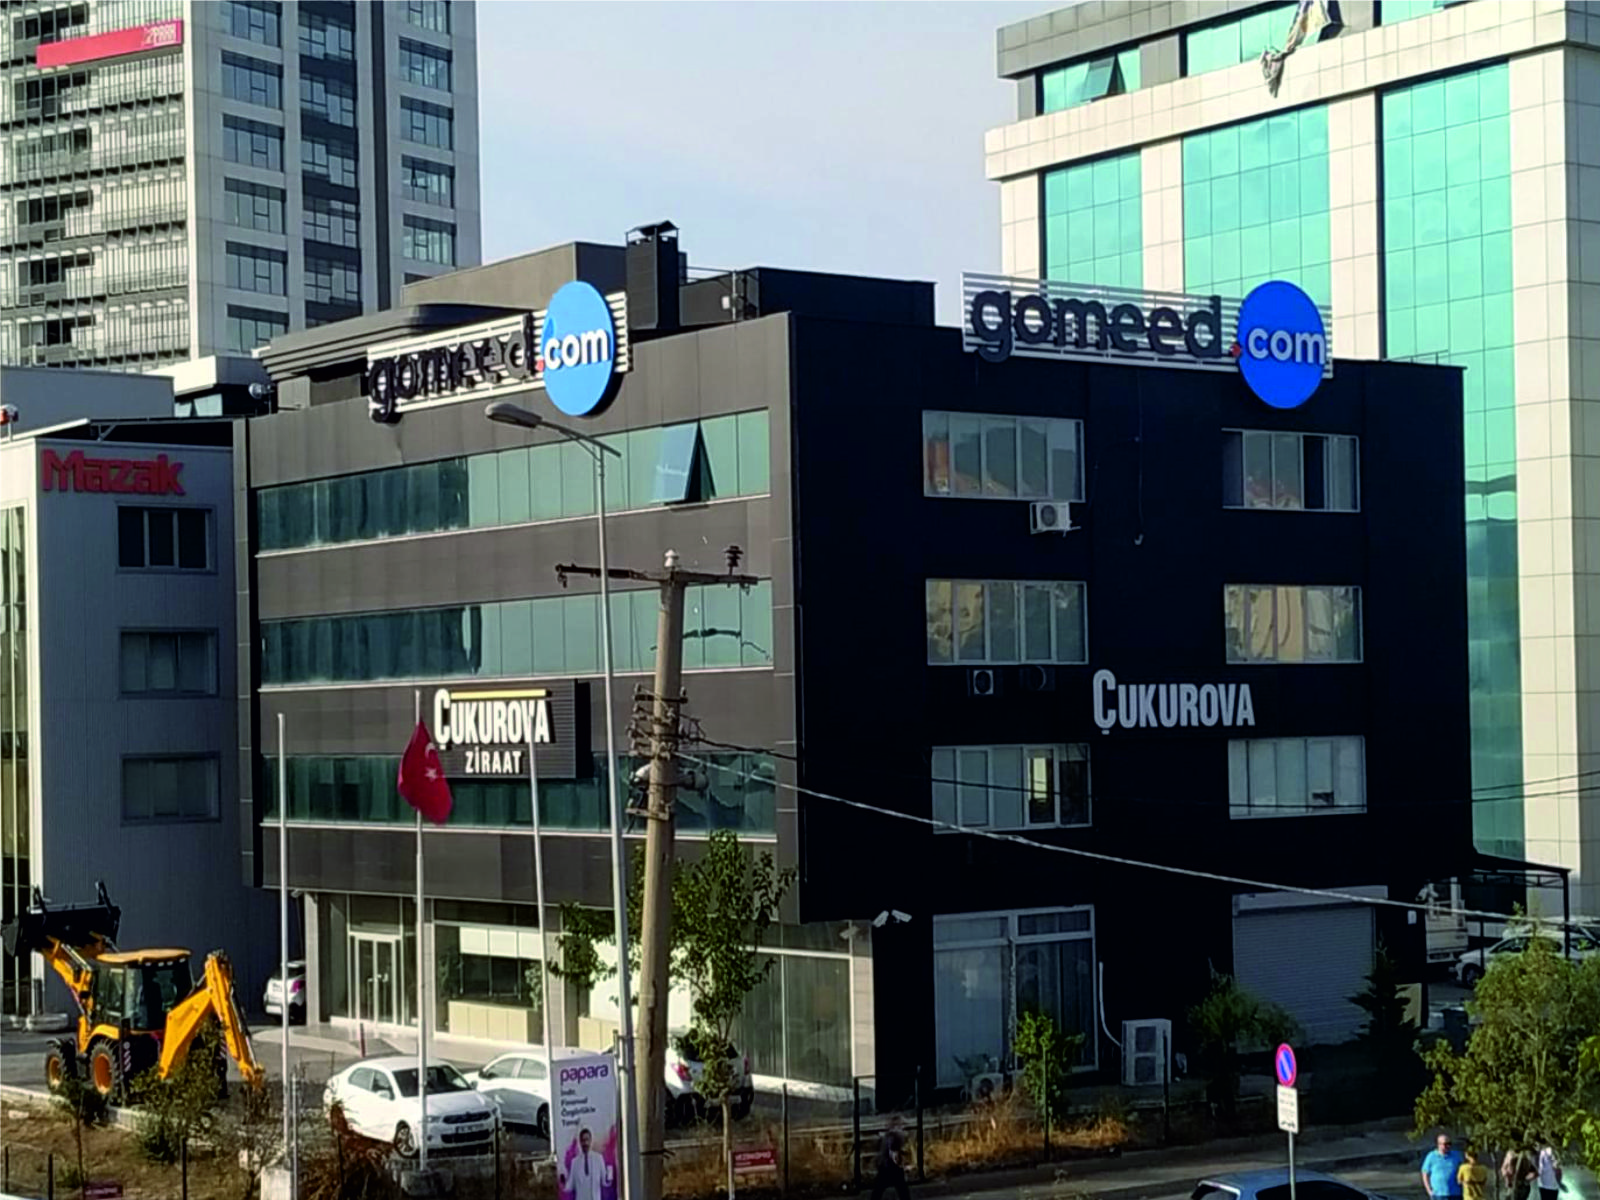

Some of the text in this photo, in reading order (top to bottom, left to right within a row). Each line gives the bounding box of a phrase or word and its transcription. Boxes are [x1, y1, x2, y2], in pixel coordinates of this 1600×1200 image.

[42, 448, 186, 496] Mazak
[434, 688, 550, 750] ÇUKUROVA
[1092, 668, 1256, 735] ÇUKUROVA
[465, 745, 522, 774] ZİRAAT
[560, 1064, 609, 1086] papara
